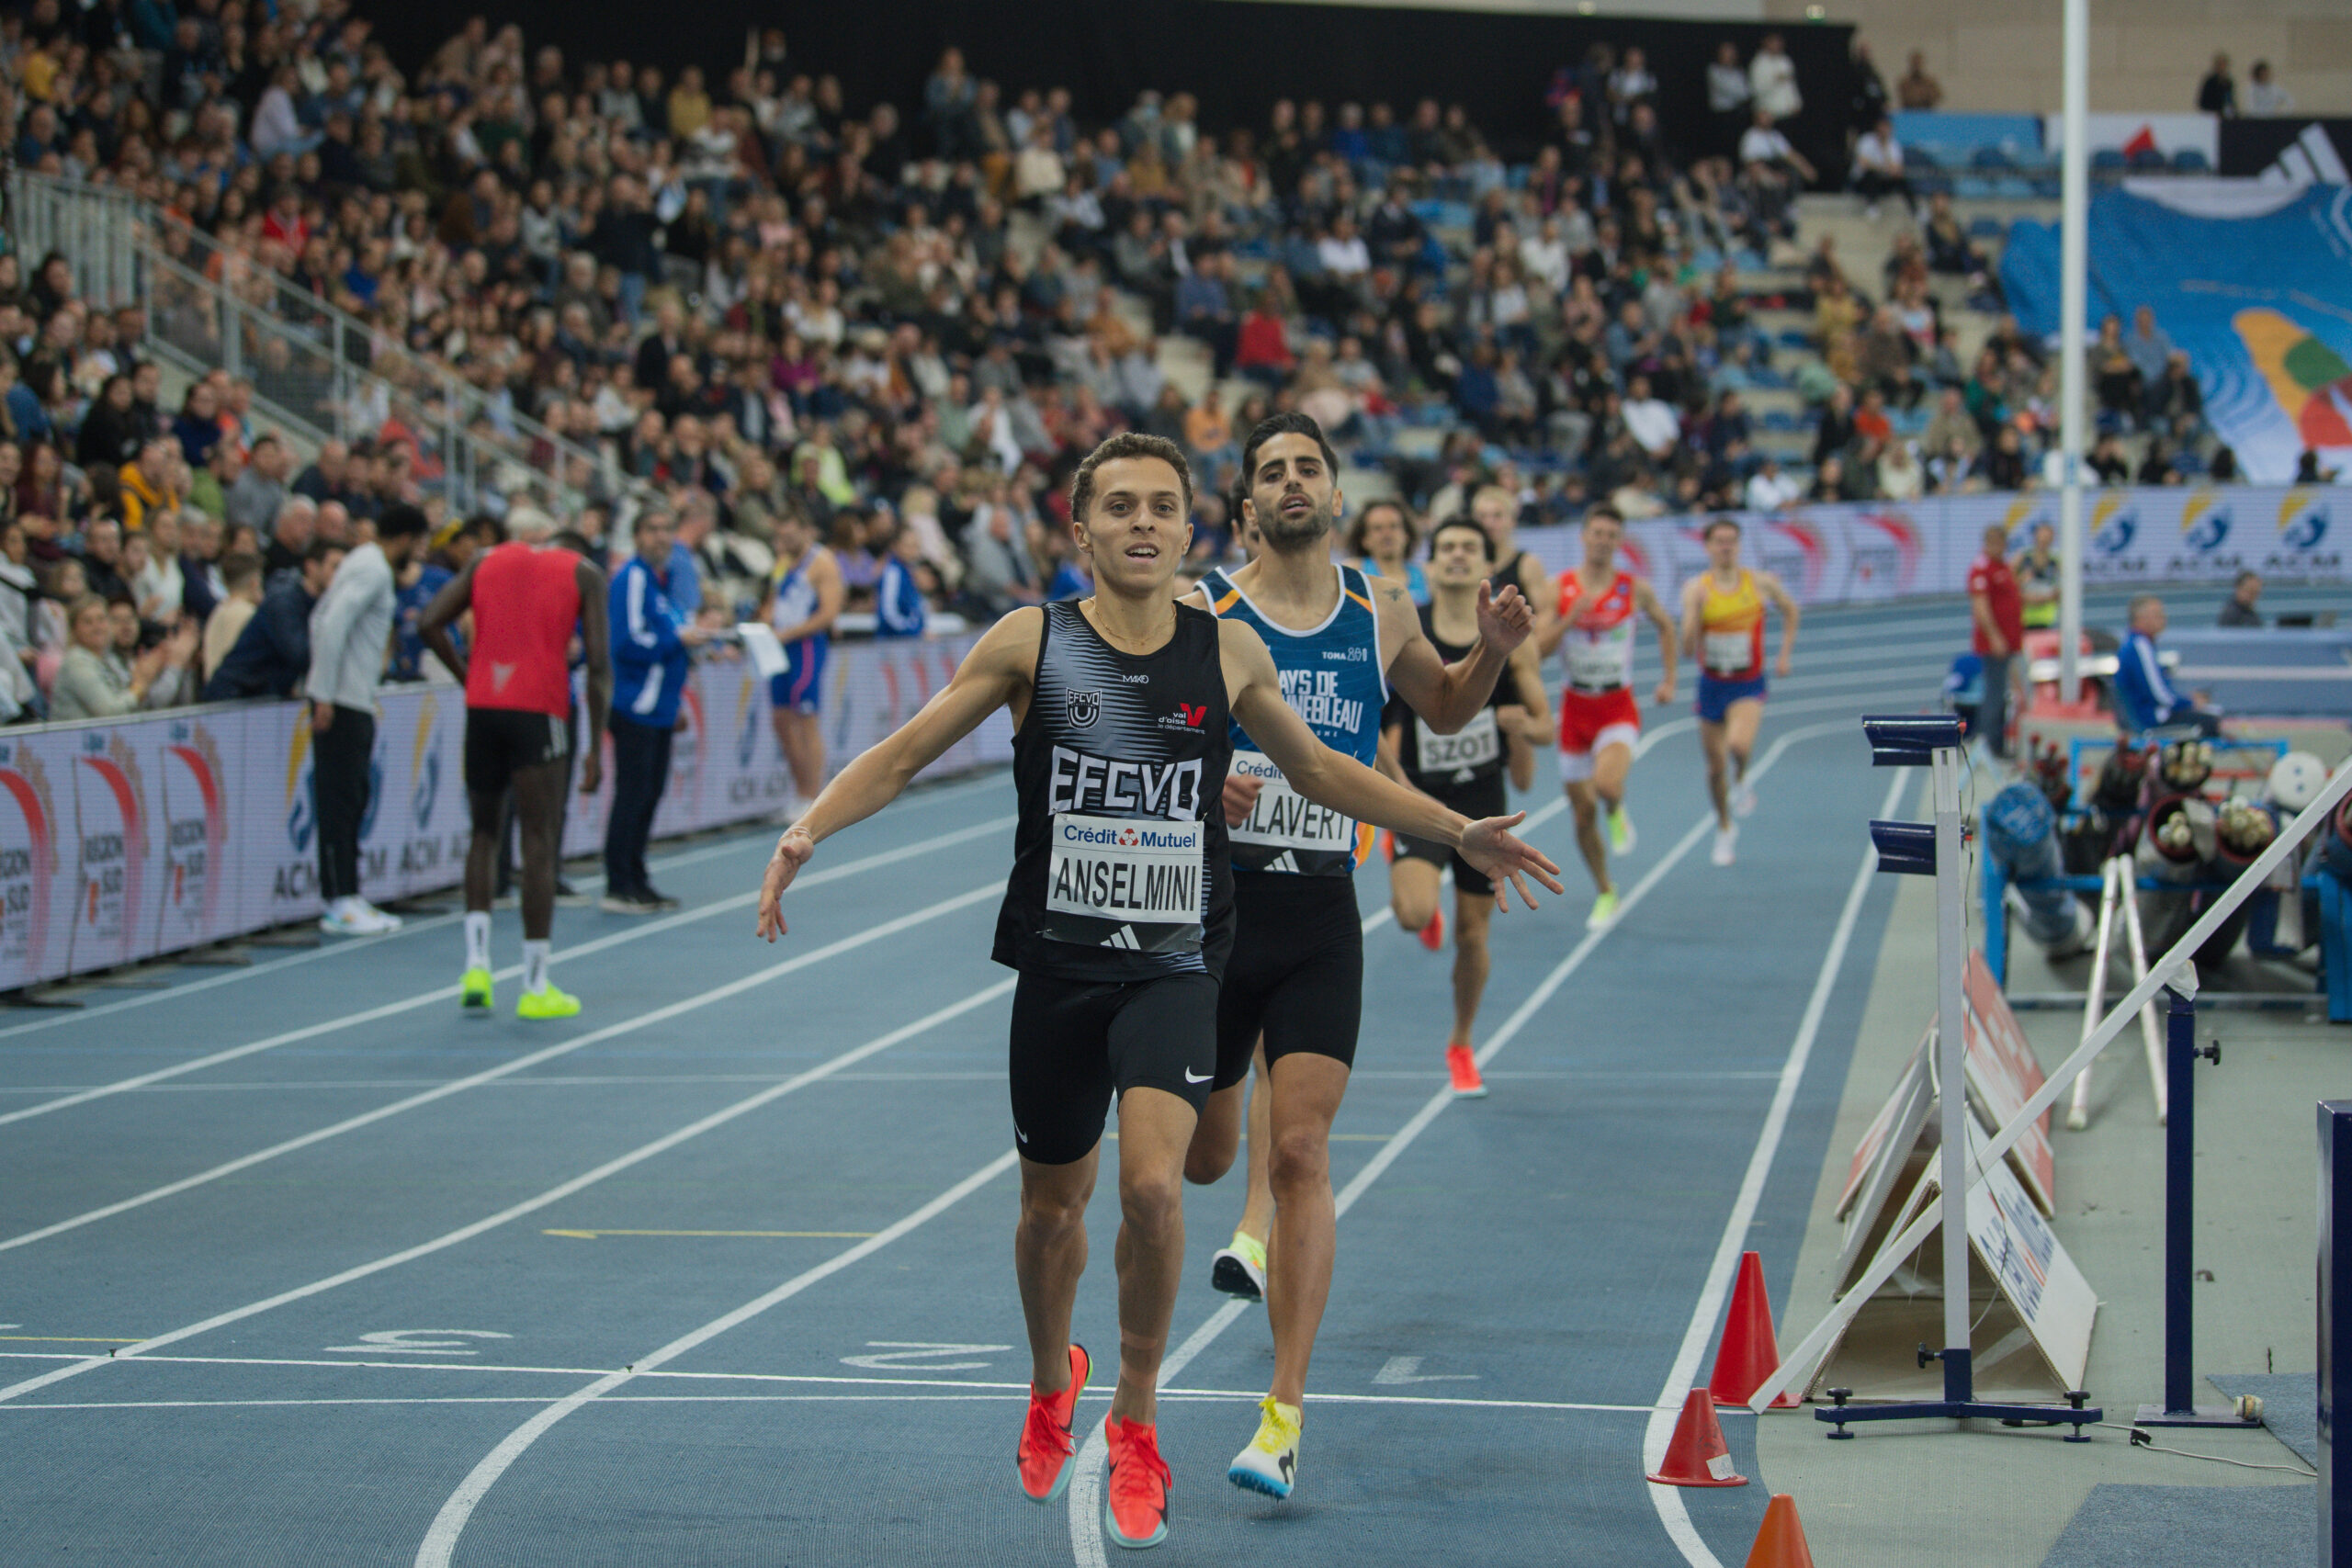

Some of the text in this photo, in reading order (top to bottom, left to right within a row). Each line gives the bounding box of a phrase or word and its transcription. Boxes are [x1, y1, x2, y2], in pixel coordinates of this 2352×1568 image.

[1069, 691, 1100, 705] EFCVO
[1278, 670, 1339, 697] AYS DE
[1158, 716, 1186, 725] d'oise
[1425, 734, 1493, 765] SZOT
[1047, 745, 1203, 821] EFCVO
[1236, 760, 1283, 779] Crédit
[1245, 794, 1344, 840] LAVER
[1064, 825, 1196, 848] Crédit Mutuel
[1053, 857, 1197, 911] ANSELMINI
[837, 1341, 1014, 1371] 2
[1371, 1356, 1481, 1385] 1
